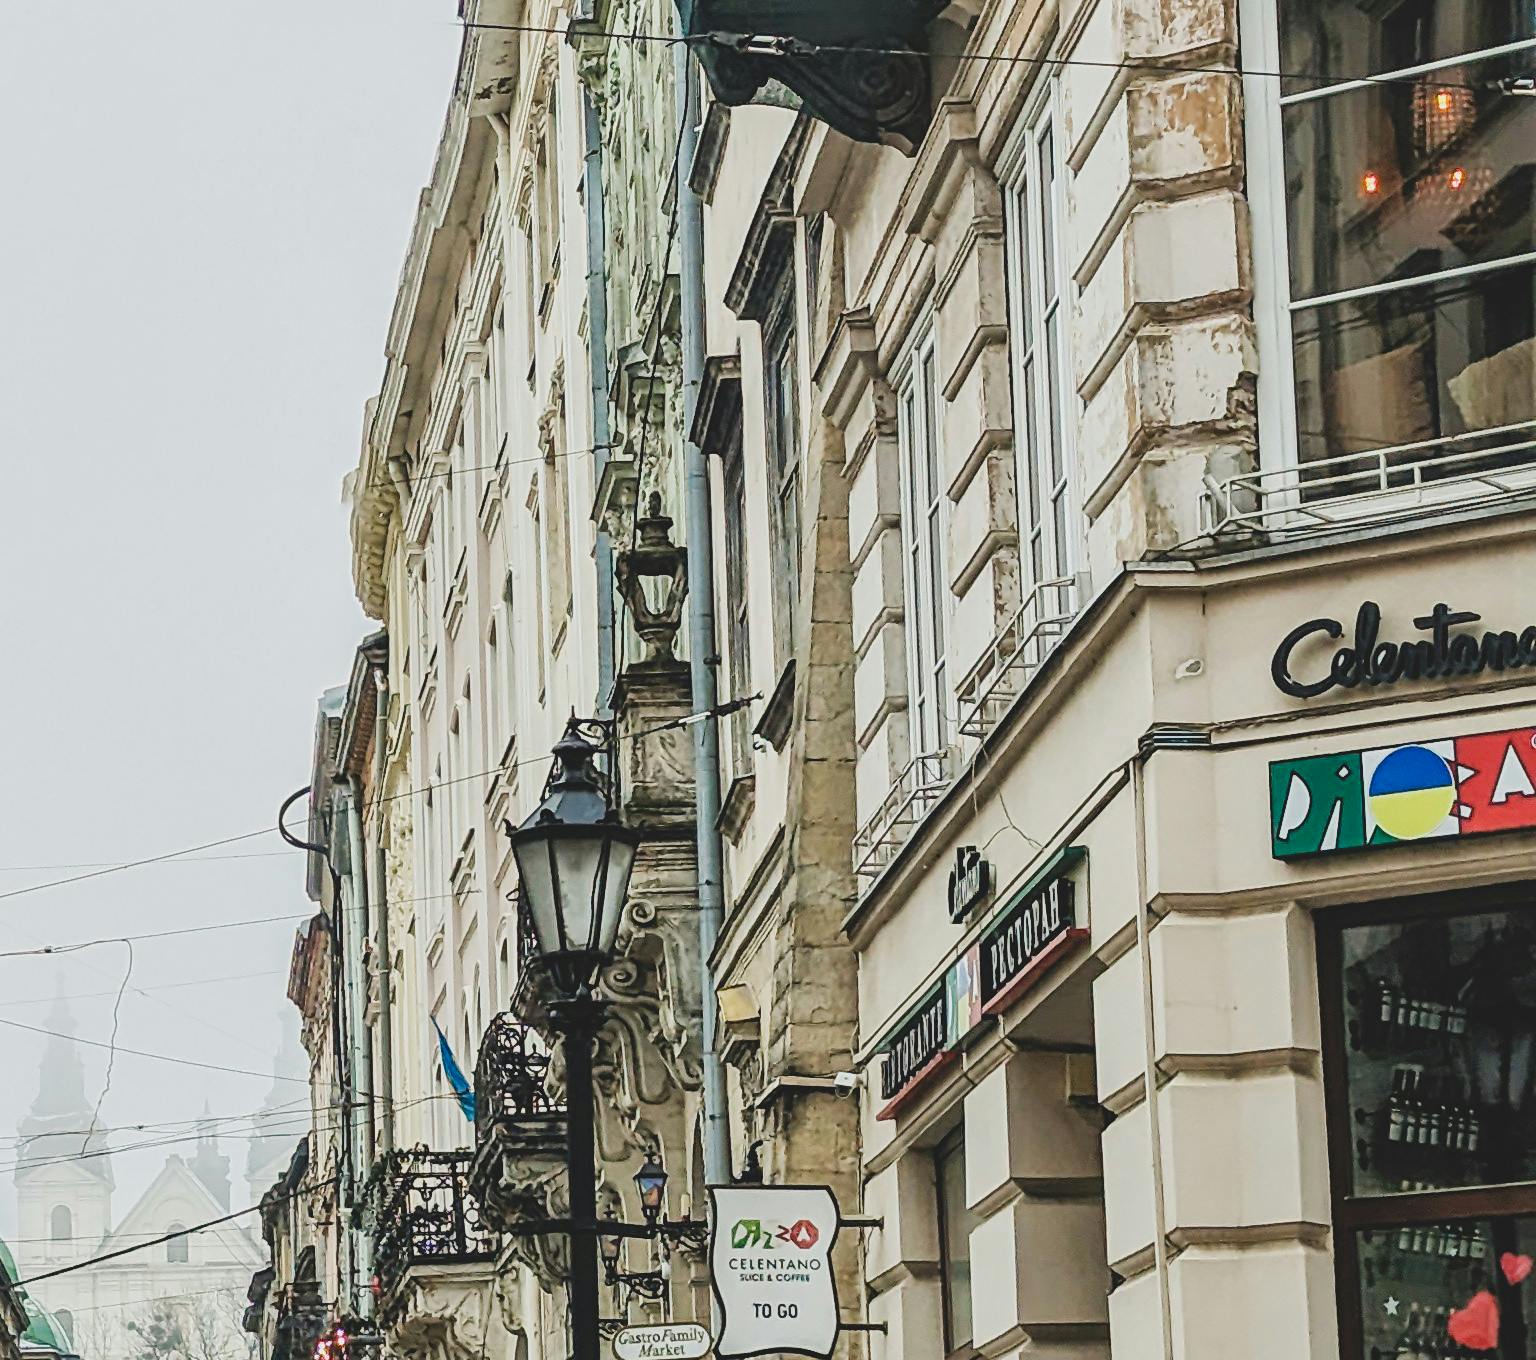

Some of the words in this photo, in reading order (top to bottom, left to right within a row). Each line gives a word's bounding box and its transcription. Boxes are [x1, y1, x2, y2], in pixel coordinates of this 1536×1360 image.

[990, 878, 1060, 990] РЕСТОРАН
[728, 1258, 821, 1271] CELENTANO
[776, 1273, 810, 1282] COFFEE
[753, 1303, 772, 1319] TO
[777, 1303, 798, 1319] GO
[638, 1344, 685, 1358] Market
